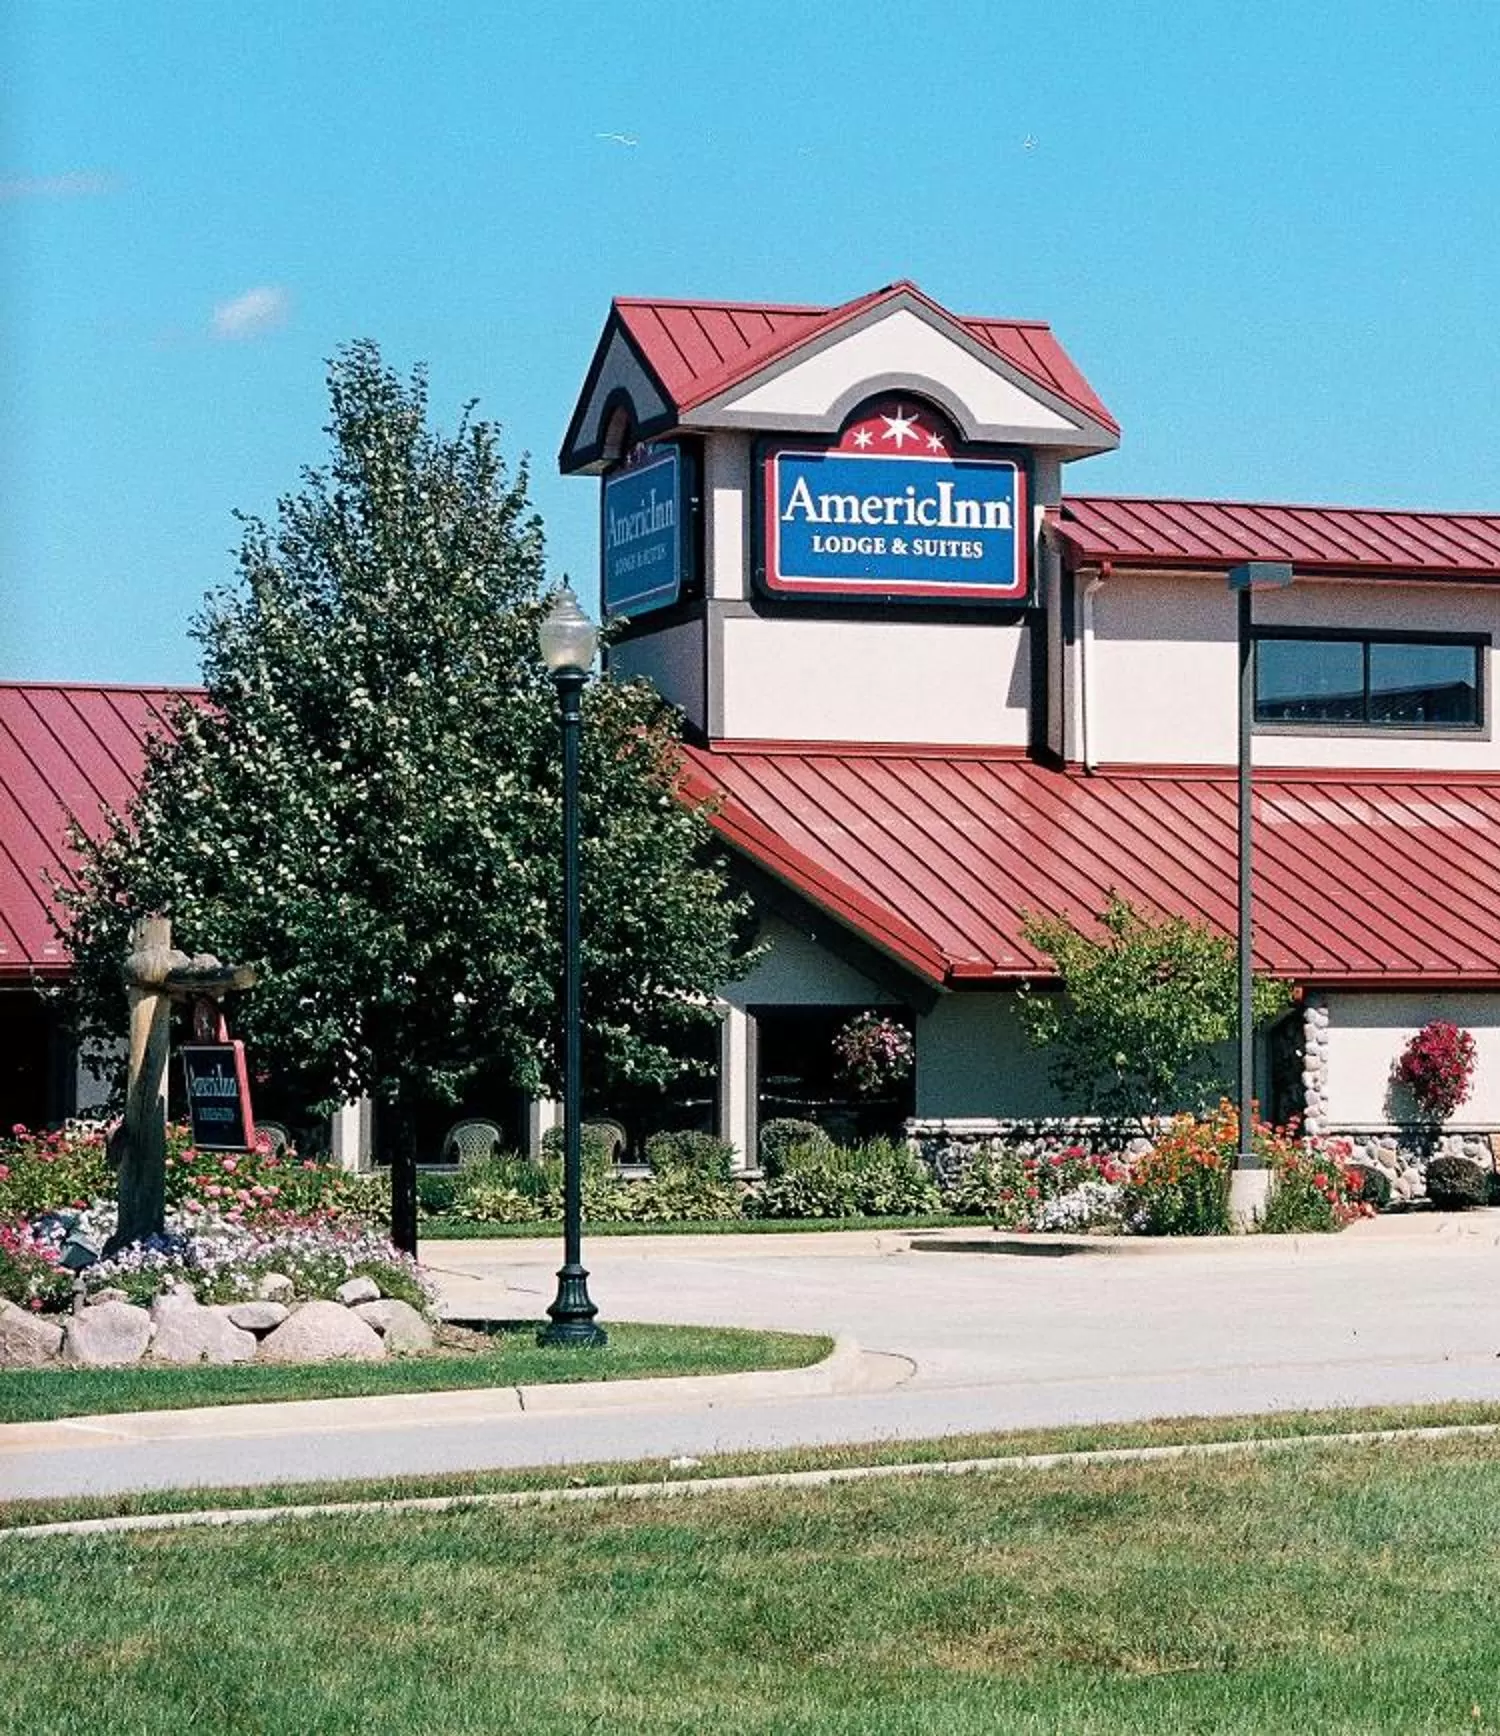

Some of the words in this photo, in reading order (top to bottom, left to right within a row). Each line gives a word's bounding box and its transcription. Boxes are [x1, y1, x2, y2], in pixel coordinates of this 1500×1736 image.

[781, 476, 1012, 529] AmericInn
[811, 535, 886, 555] LODGE
[892, 538, 908, 556] &
[913, 539, 983, 559] SUITES
